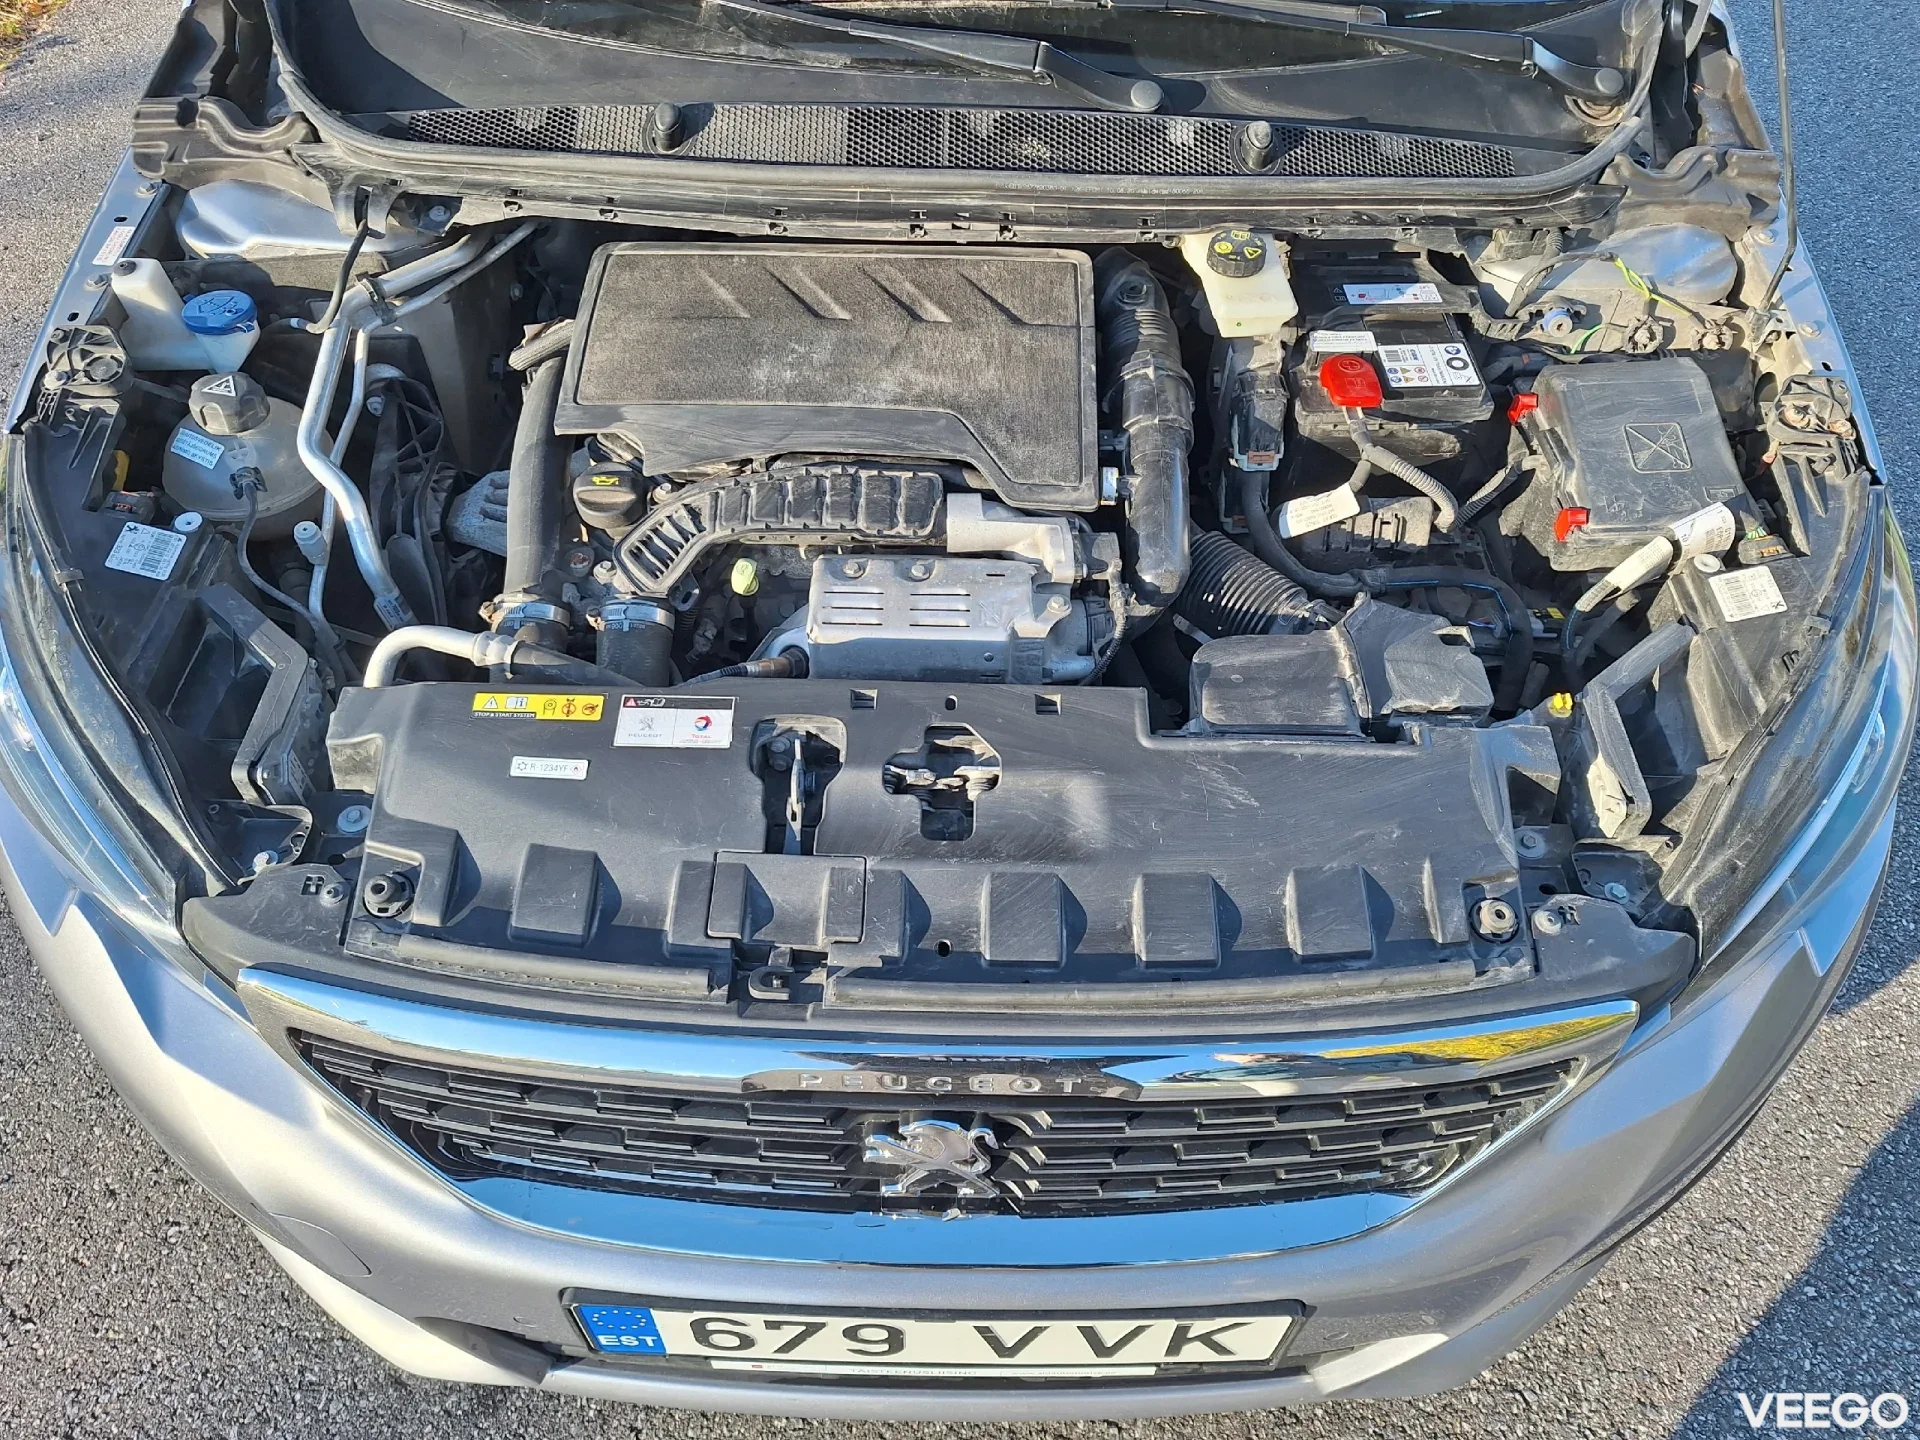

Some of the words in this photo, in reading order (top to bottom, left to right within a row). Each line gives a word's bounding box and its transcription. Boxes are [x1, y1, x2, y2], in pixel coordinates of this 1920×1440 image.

[529, 762, 569, 773] R-1234YF
[800, 1073, 1082, 1093] PEUGEOT
[596, 1334, 659, 1348] EST
[689, 1316, 907, 1357] 679
[972, 1320, 1258, 1359] VVK
